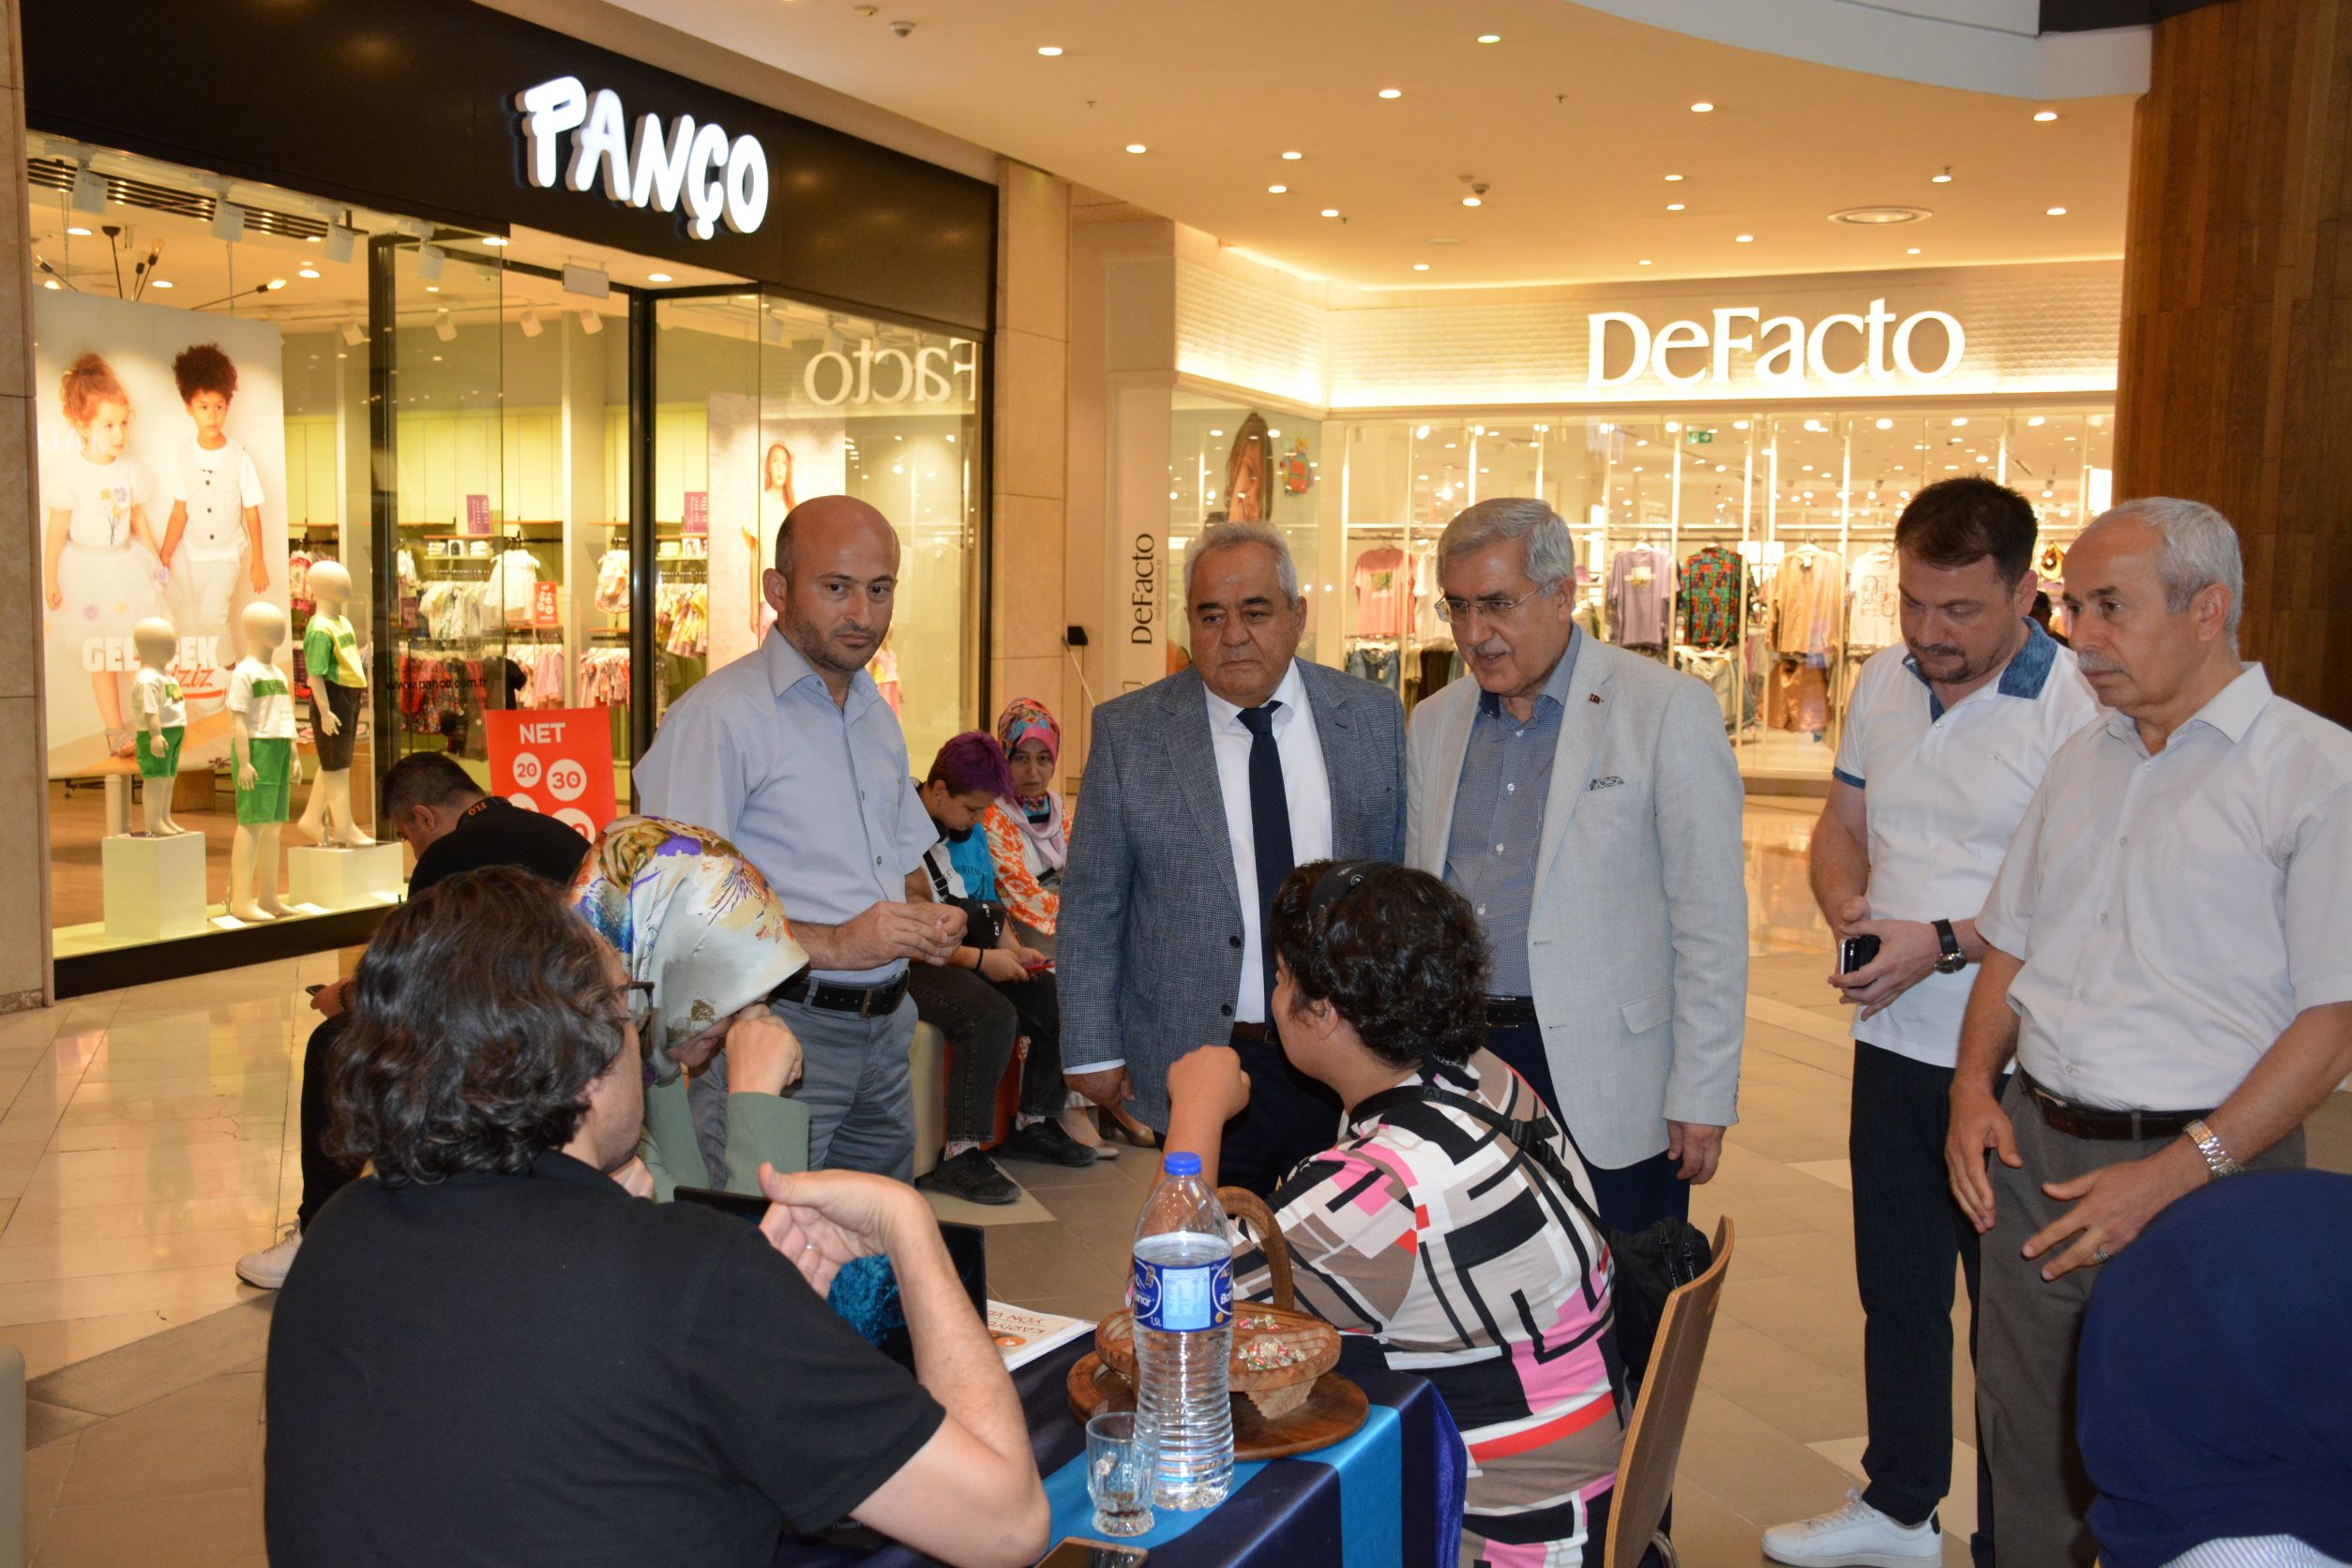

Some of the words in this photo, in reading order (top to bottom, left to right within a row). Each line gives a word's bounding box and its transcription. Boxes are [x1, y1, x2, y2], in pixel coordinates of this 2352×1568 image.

[516, 76, 769, 240] PANÇO
[1587, 297, 1966, 387] DeFacto
[1131, 533, 1154, 645] DeFacto
[83, 636, 219, 672] GELEK
[519, 722, 566, 745] NET
[517, 762, 537, 778] 20
[551, 771, 581, 790] 30
[468, 802, 487, 816] FLO
